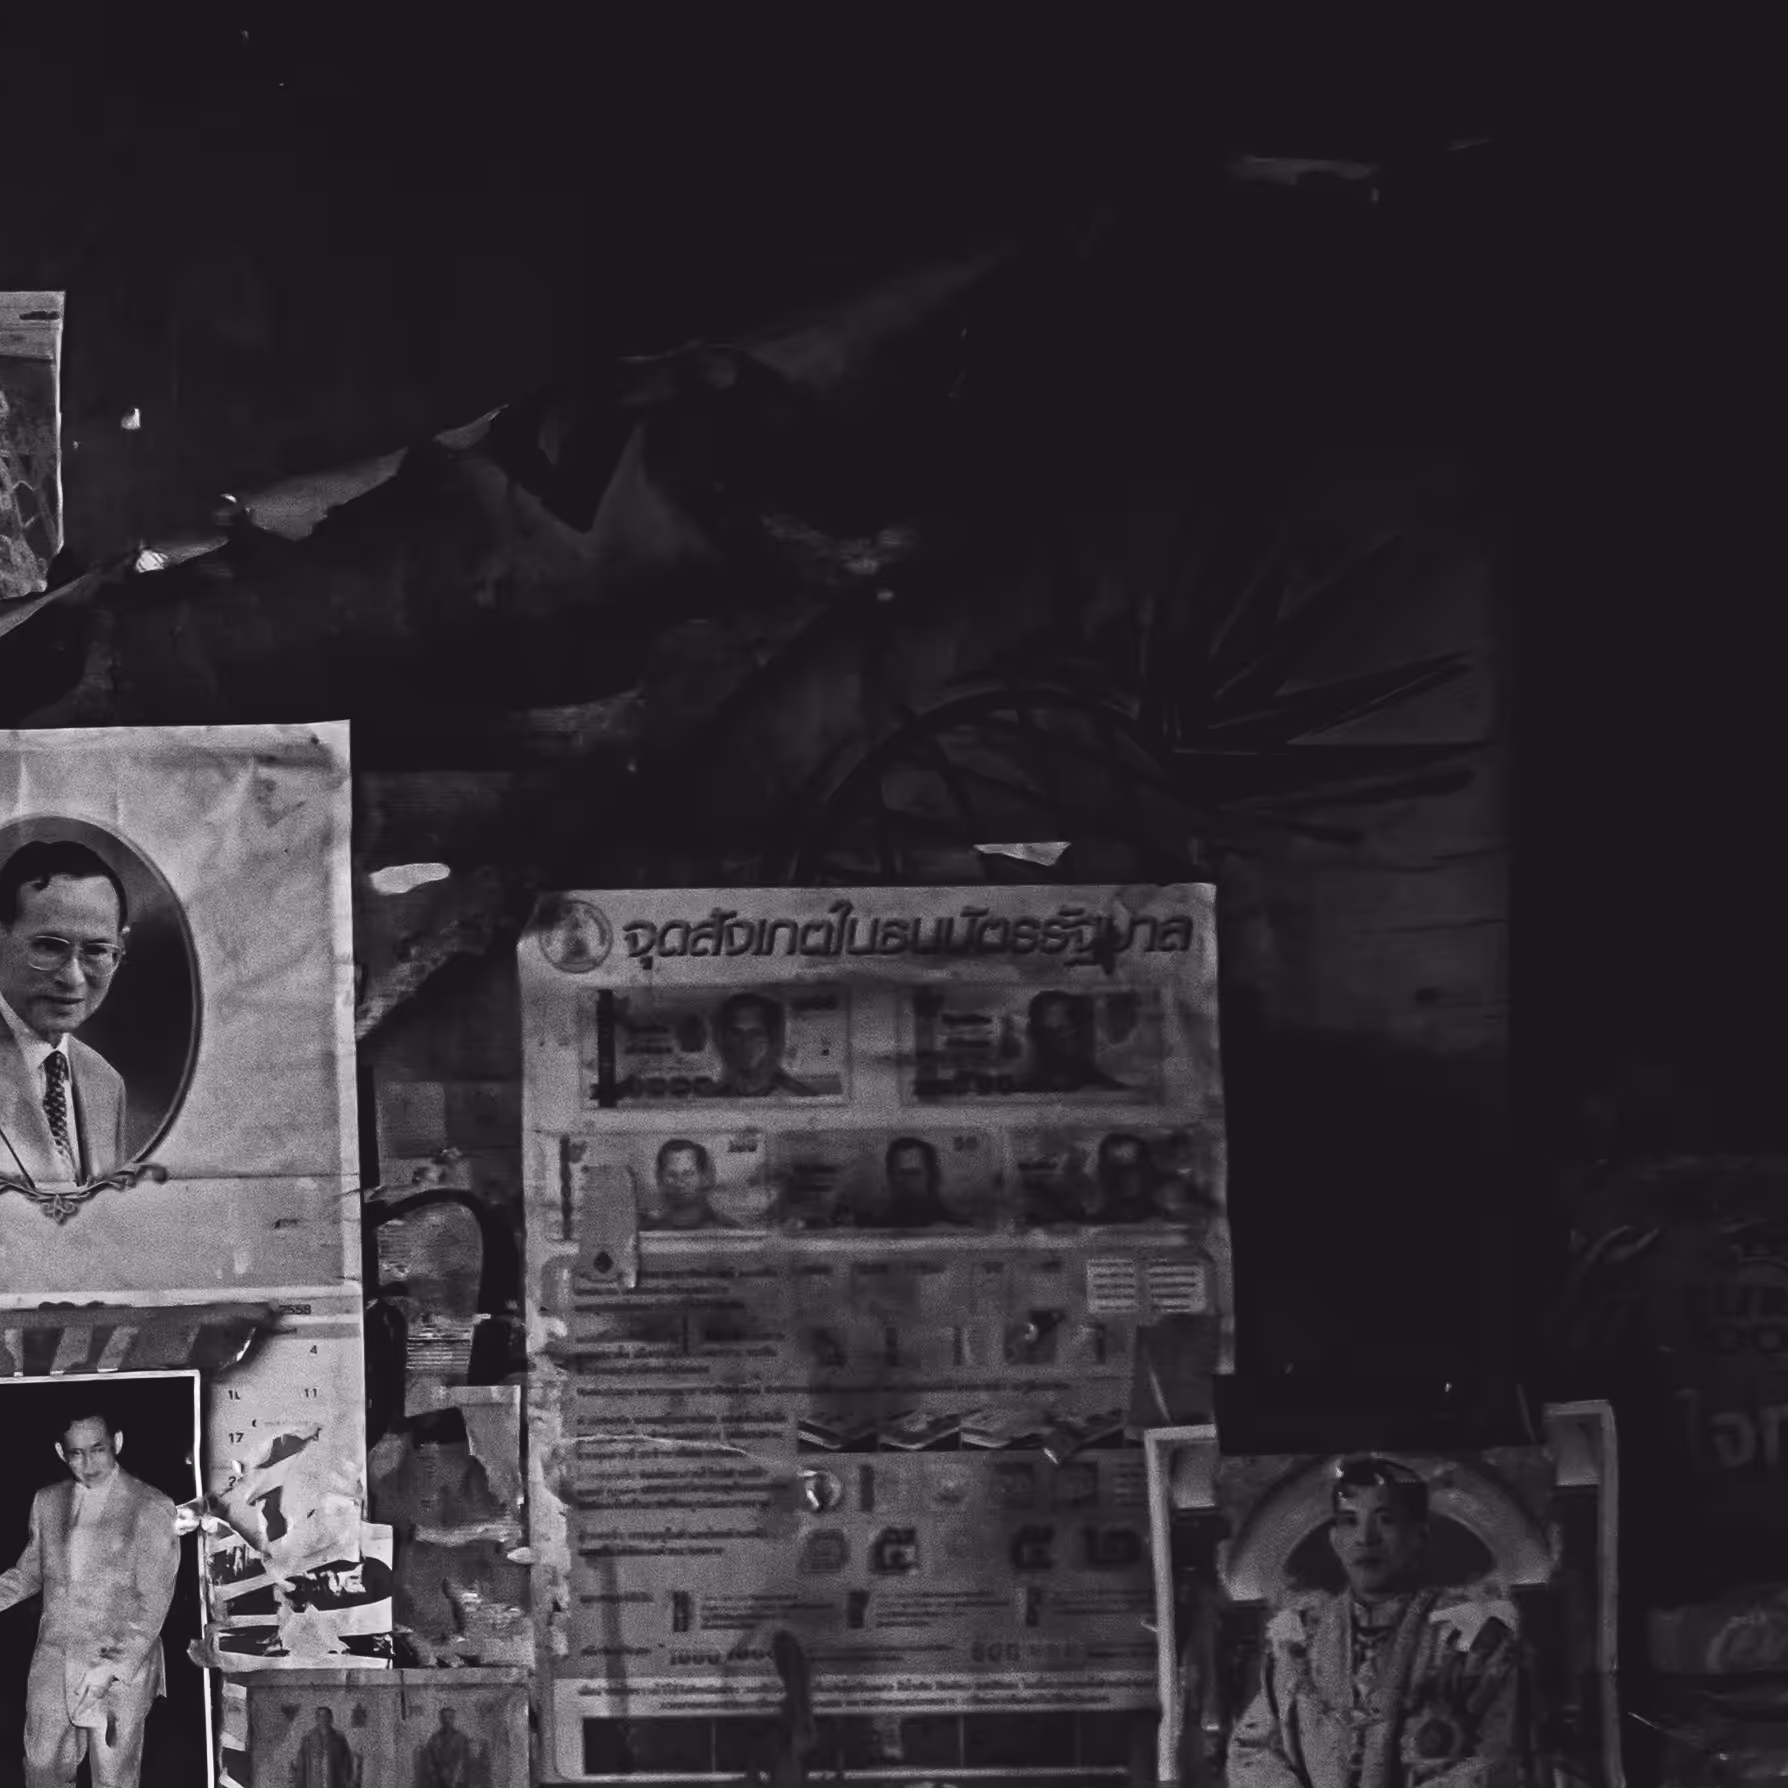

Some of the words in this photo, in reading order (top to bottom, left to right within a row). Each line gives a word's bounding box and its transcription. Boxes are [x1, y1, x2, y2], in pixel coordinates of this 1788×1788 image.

[310, 1345, 318, 1354] 4
[304, 1388, 317, 1399] 11
[228, 1432, 245, 1443] 17
